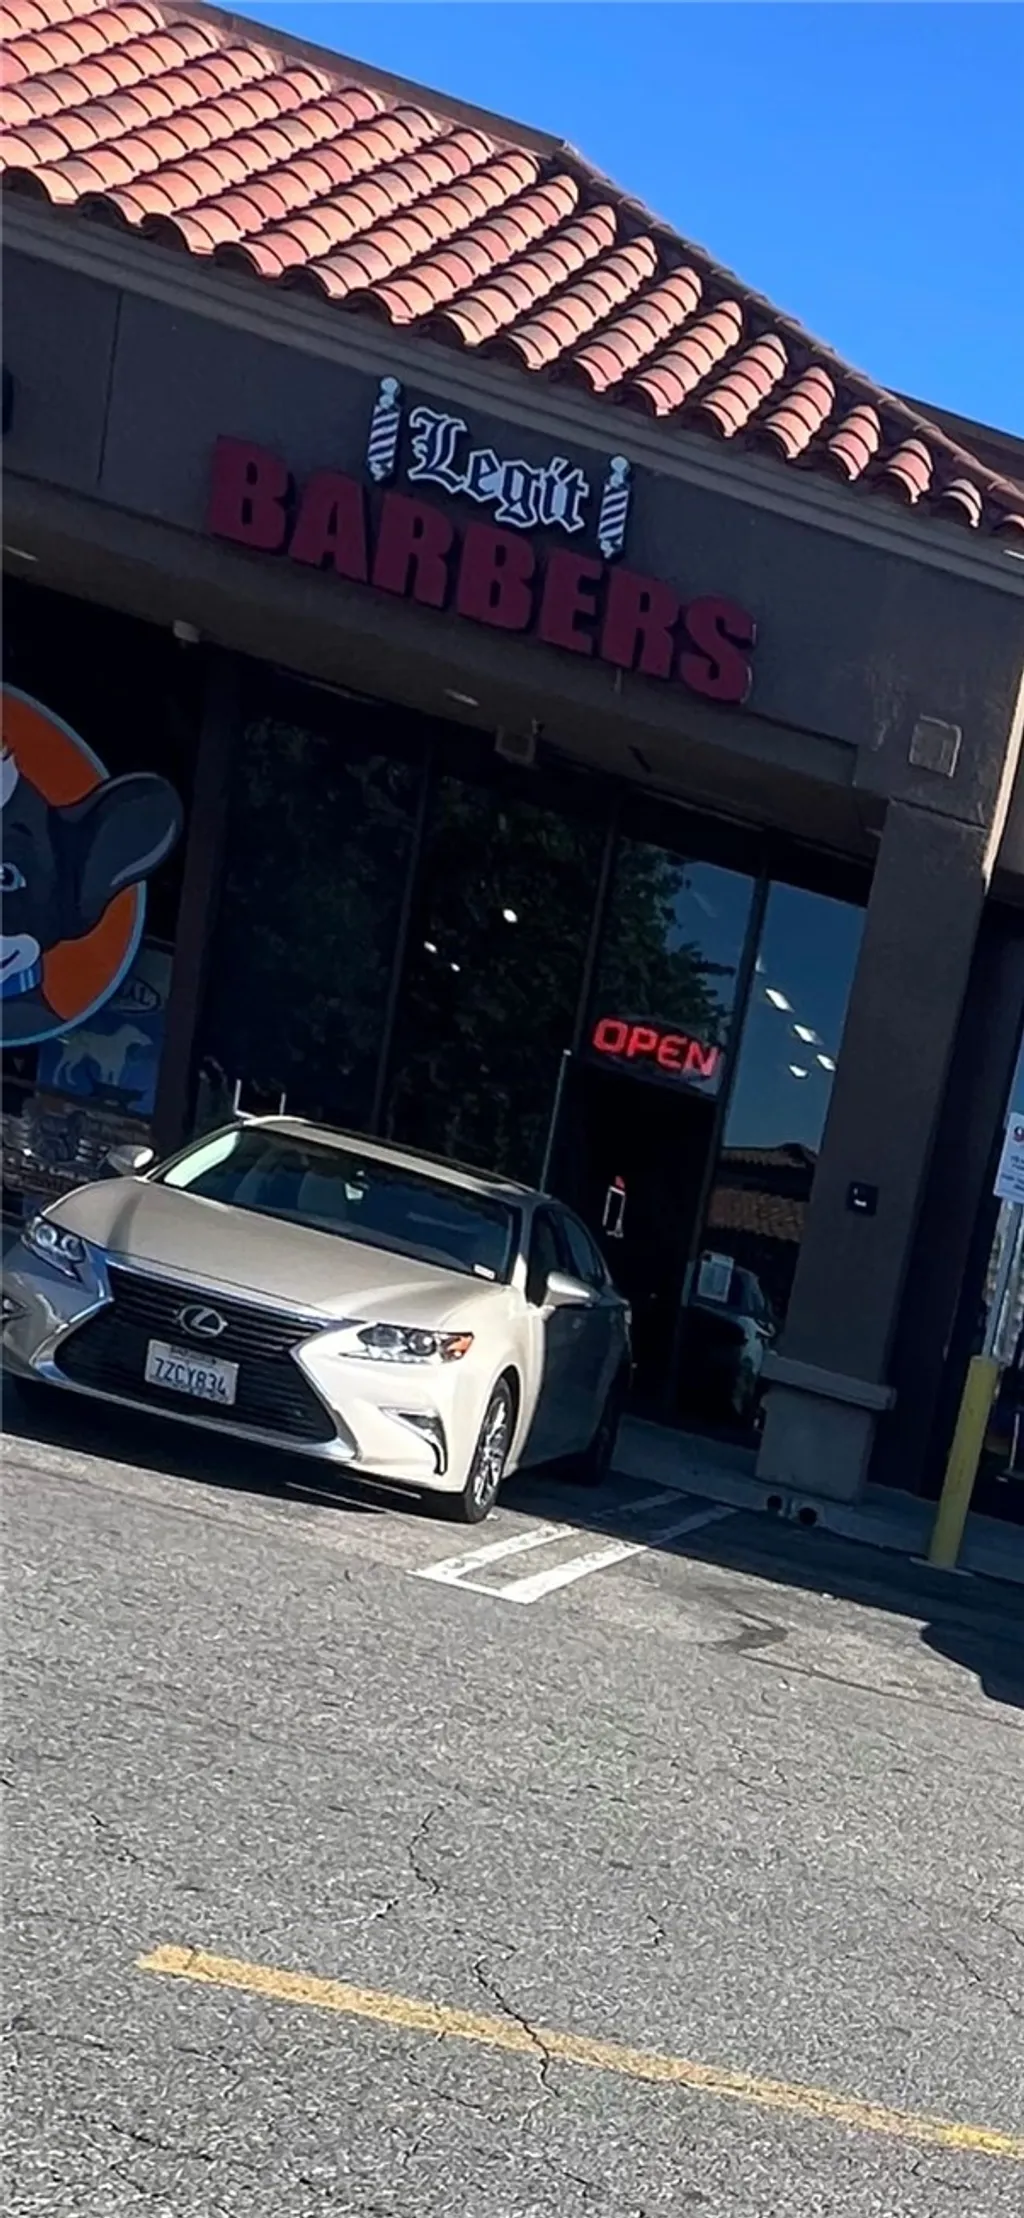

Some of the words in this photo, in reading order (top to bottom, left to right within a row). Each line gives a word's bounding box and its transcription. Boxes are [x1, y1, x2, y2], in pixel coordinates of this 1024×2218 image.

[406, 406, 590, 532] Legit
[209, 434, 756, 704] BARBERS
[593, 1018, 718, 1076] OPEN
